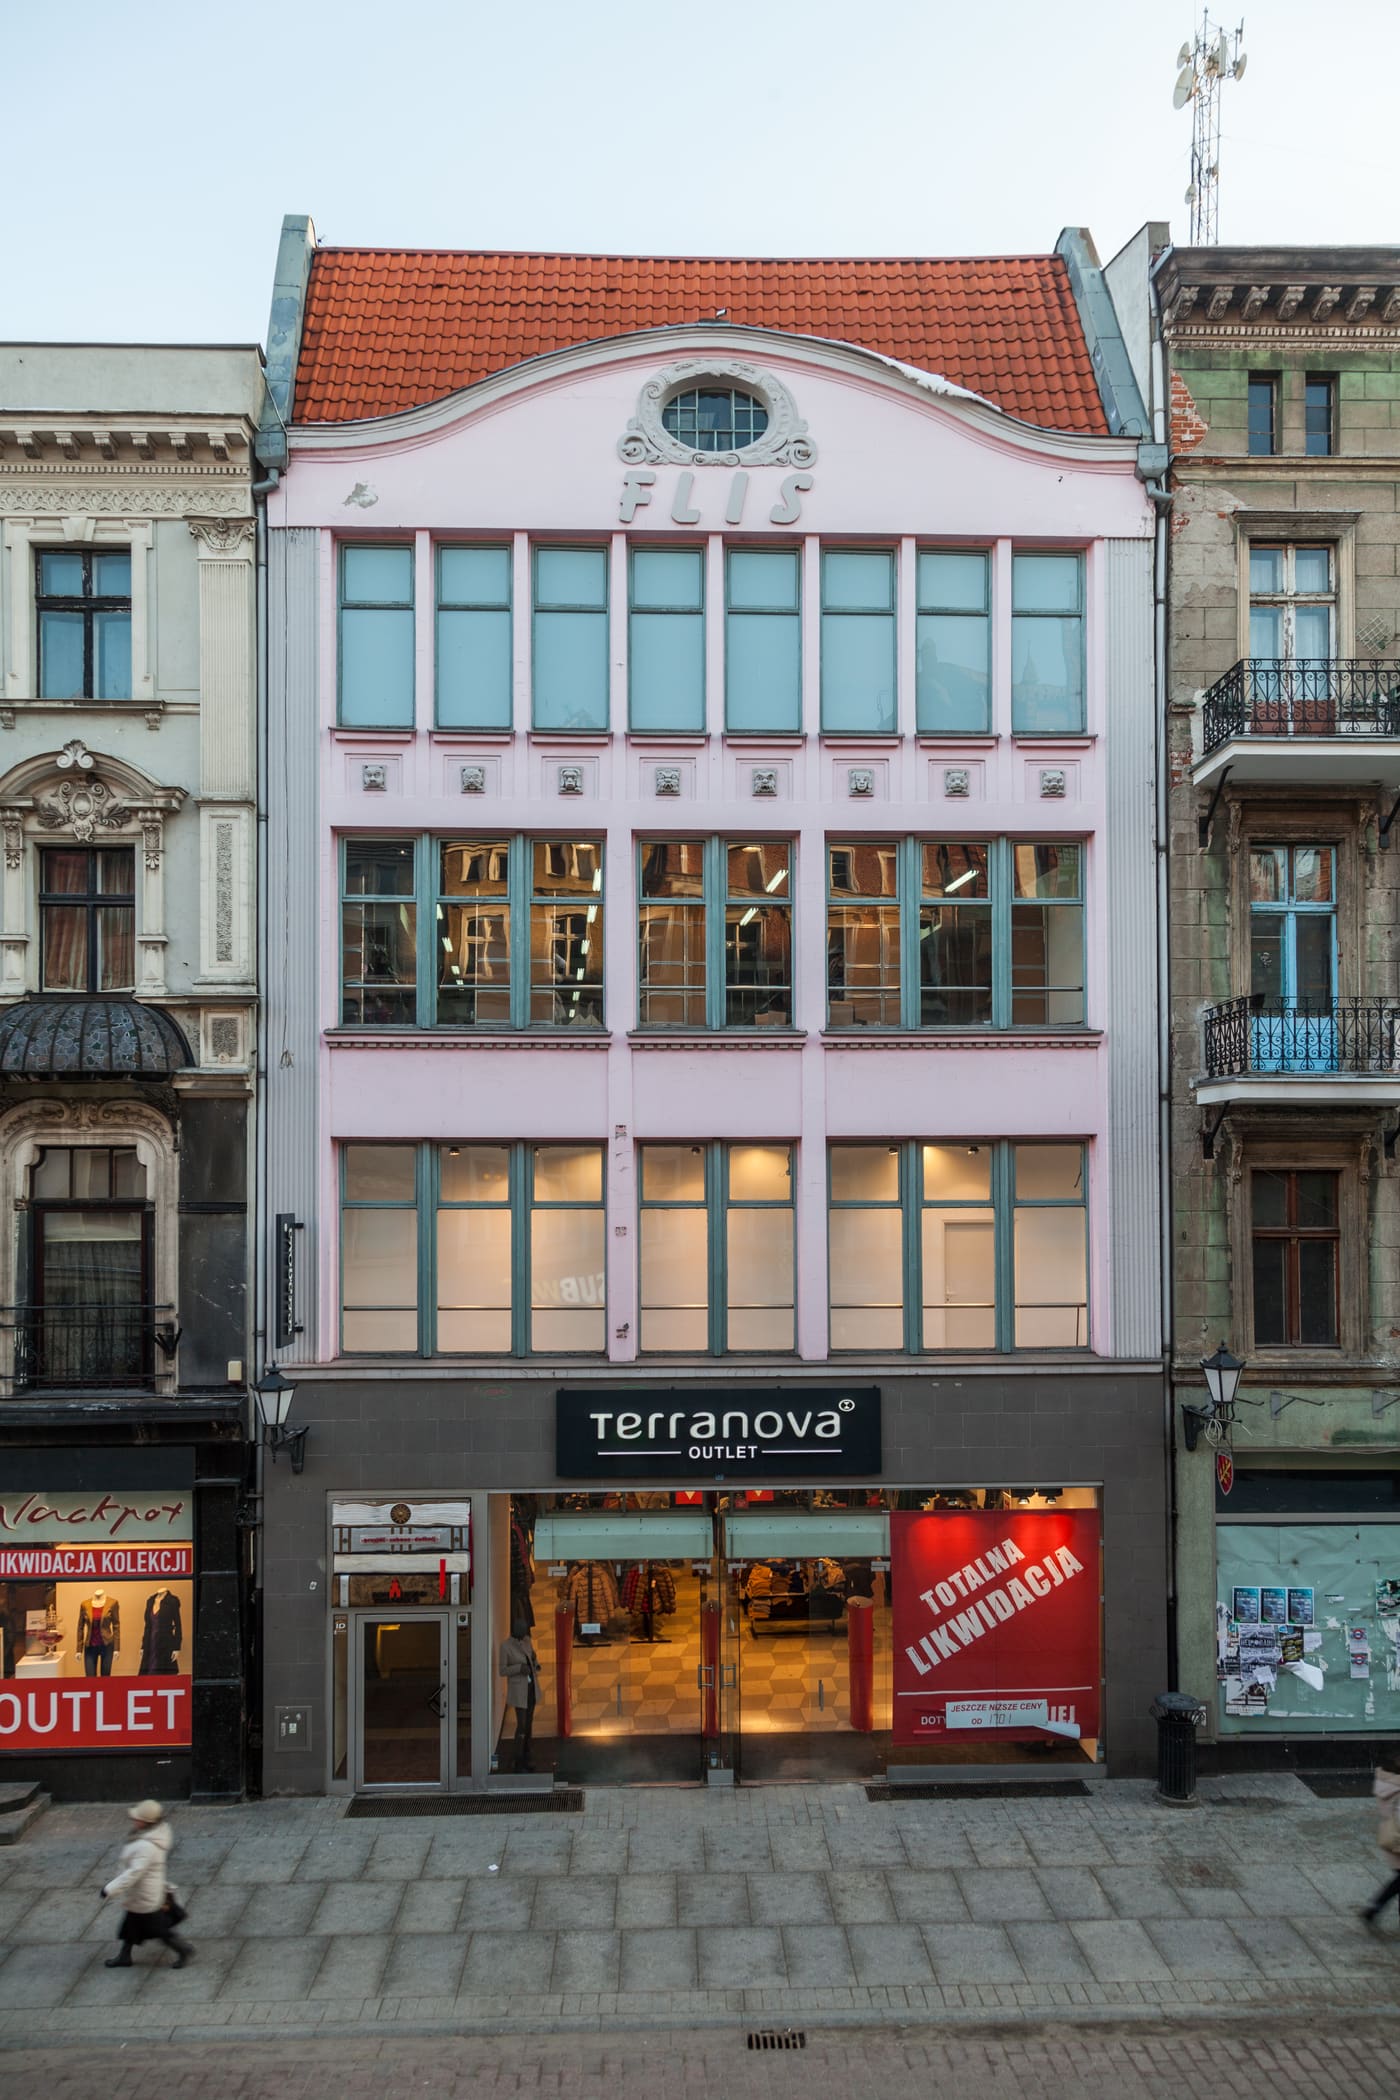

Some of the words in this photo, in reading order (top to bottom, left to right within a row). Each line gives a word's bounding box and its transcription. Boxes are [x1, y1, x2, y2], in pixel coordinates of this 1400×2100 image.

[618, 470, 814, 524] FLIS
[590, 1411, 842, 1439] Terranova
[688, 1446, 758, 1460] OUTLET
[0, 1552, 97, 1574] IKWIDACJA
[102, 1550, 187, 1573] KOLEKCJI
[919, 1537, 1026, 1616] TOTALNA
[904, 1545, 1085, 1676] LIKWIDACJA
[0, 1689, 186, 1734] OUTLET
[950, 1703, 987, 1713] JESZCZE
[1019, 1702, 1043, 1710] CENY
